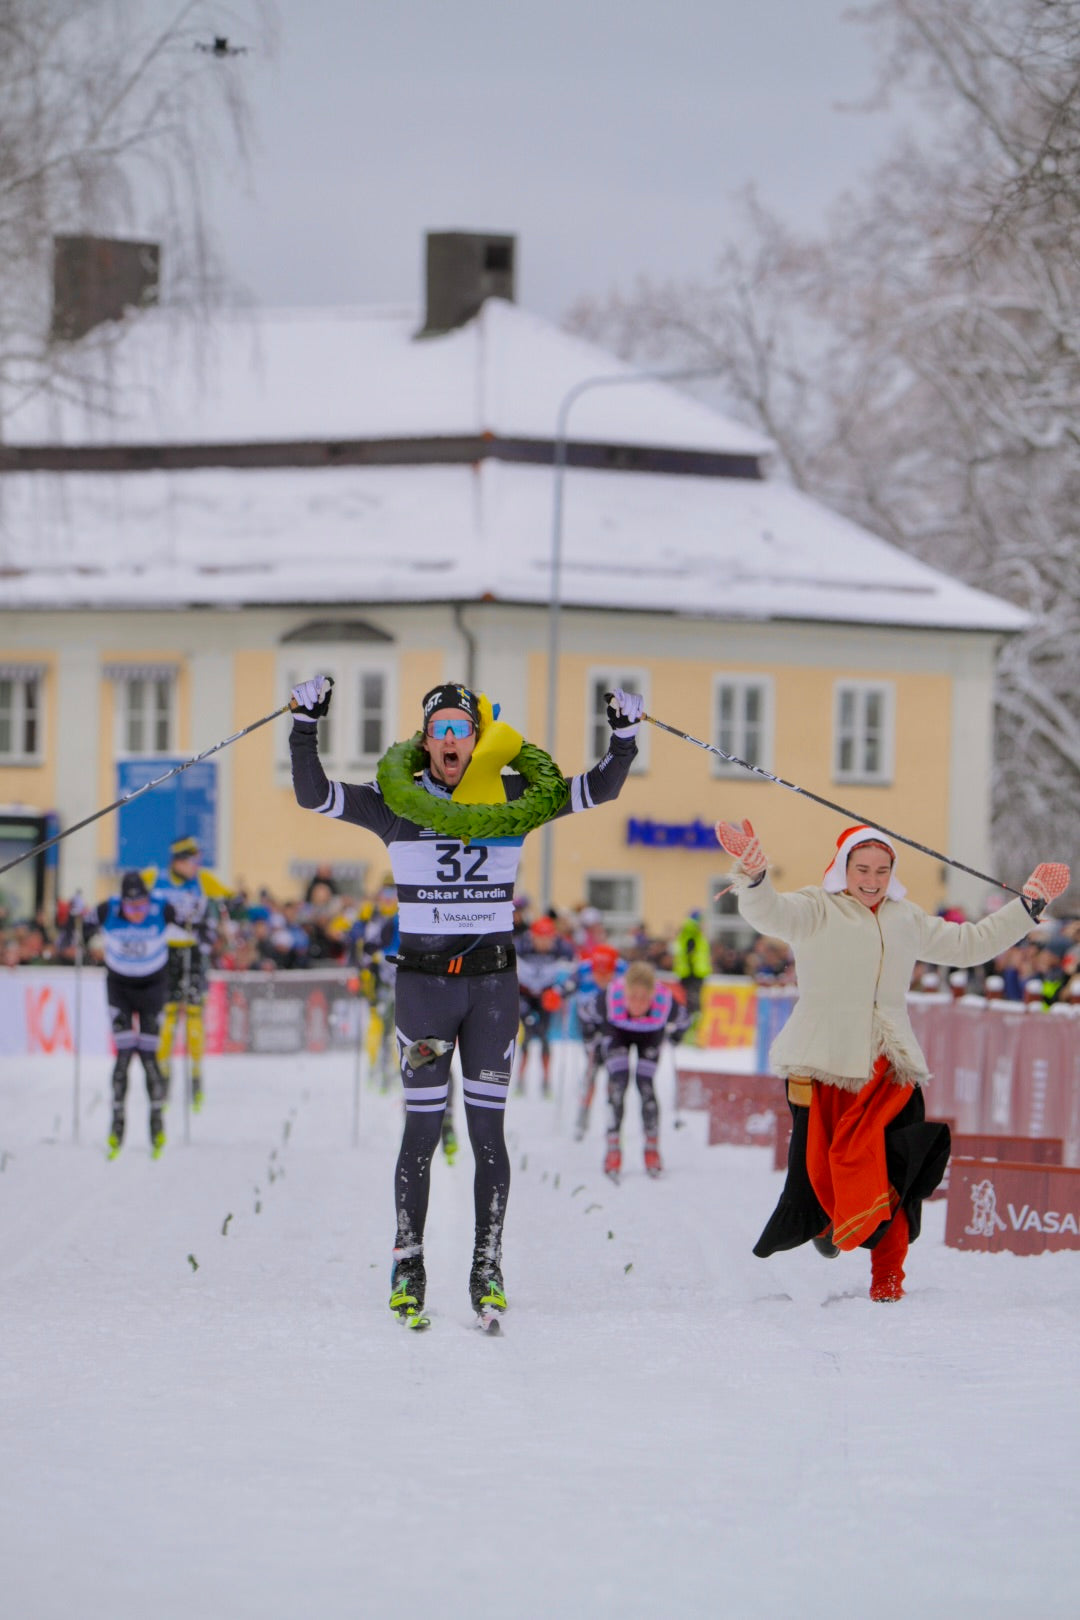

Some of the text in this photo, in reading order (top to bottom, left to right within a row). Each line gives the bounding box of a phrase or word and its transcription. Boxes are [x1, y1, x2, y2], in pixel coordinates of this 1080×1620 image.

[435, 843, 489, 883] 32
[416, 887, 507, 901] Oskar Kardin
[24, 983, 75, 1056] ICA
[1007, 1202, 1080, 1236] VASA
